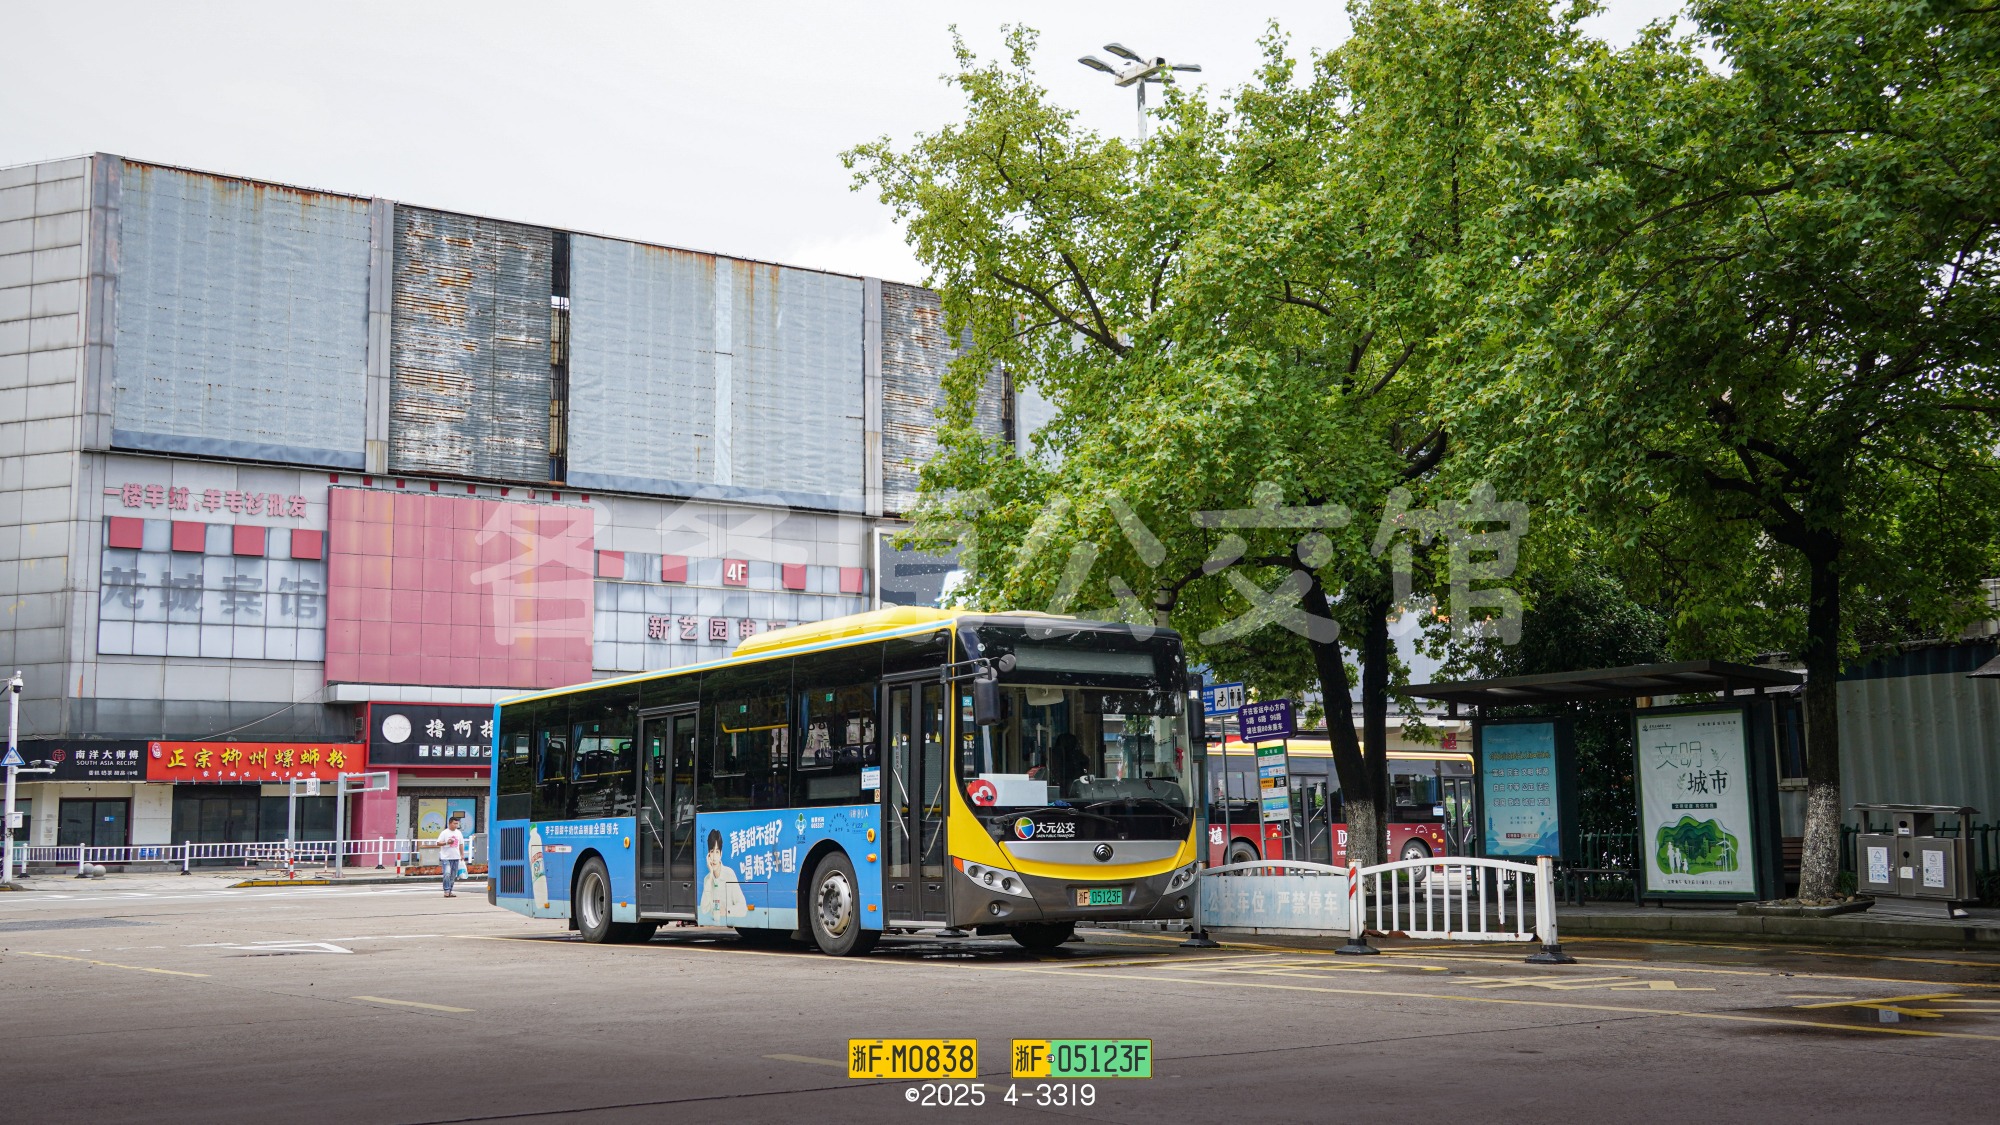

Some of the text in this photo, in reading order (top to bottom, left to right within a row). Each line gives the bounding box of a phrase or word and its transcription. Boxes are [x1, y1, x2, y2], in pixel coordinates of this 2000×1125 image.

[103, 482, 307, 518] 一楼羊绒、羊毛衫批发
[727, 563, 747, 582] 4F
[101, 566, 320, 619] 龙城宾馆
[1242, 703, 1286, 716] 开往客运中心方向
[75, 749, 139, 760] 南洋大师傅
[166, 747, 347, 769] 正宗柳州螺蛳粉
[1655, 741, 1703, 769] 文明
[1507, 768, 1519, 776] 民主
[1521, 768, 1533, 776] 文明
[1536, 767, 1549, 776] 和谐
[1522, 783, 1534, 791] 公正
[1687, 770, 1728, 795] 城市
[545, 822, 619, 836] 李子园甜牛奶饮品销量全国领先
[1036, 822, 1076, 833] 大元公交
[1208, 826, 1224, 845] 植
[1209, 890, 1338, 916] 公交车位 严禁停车
